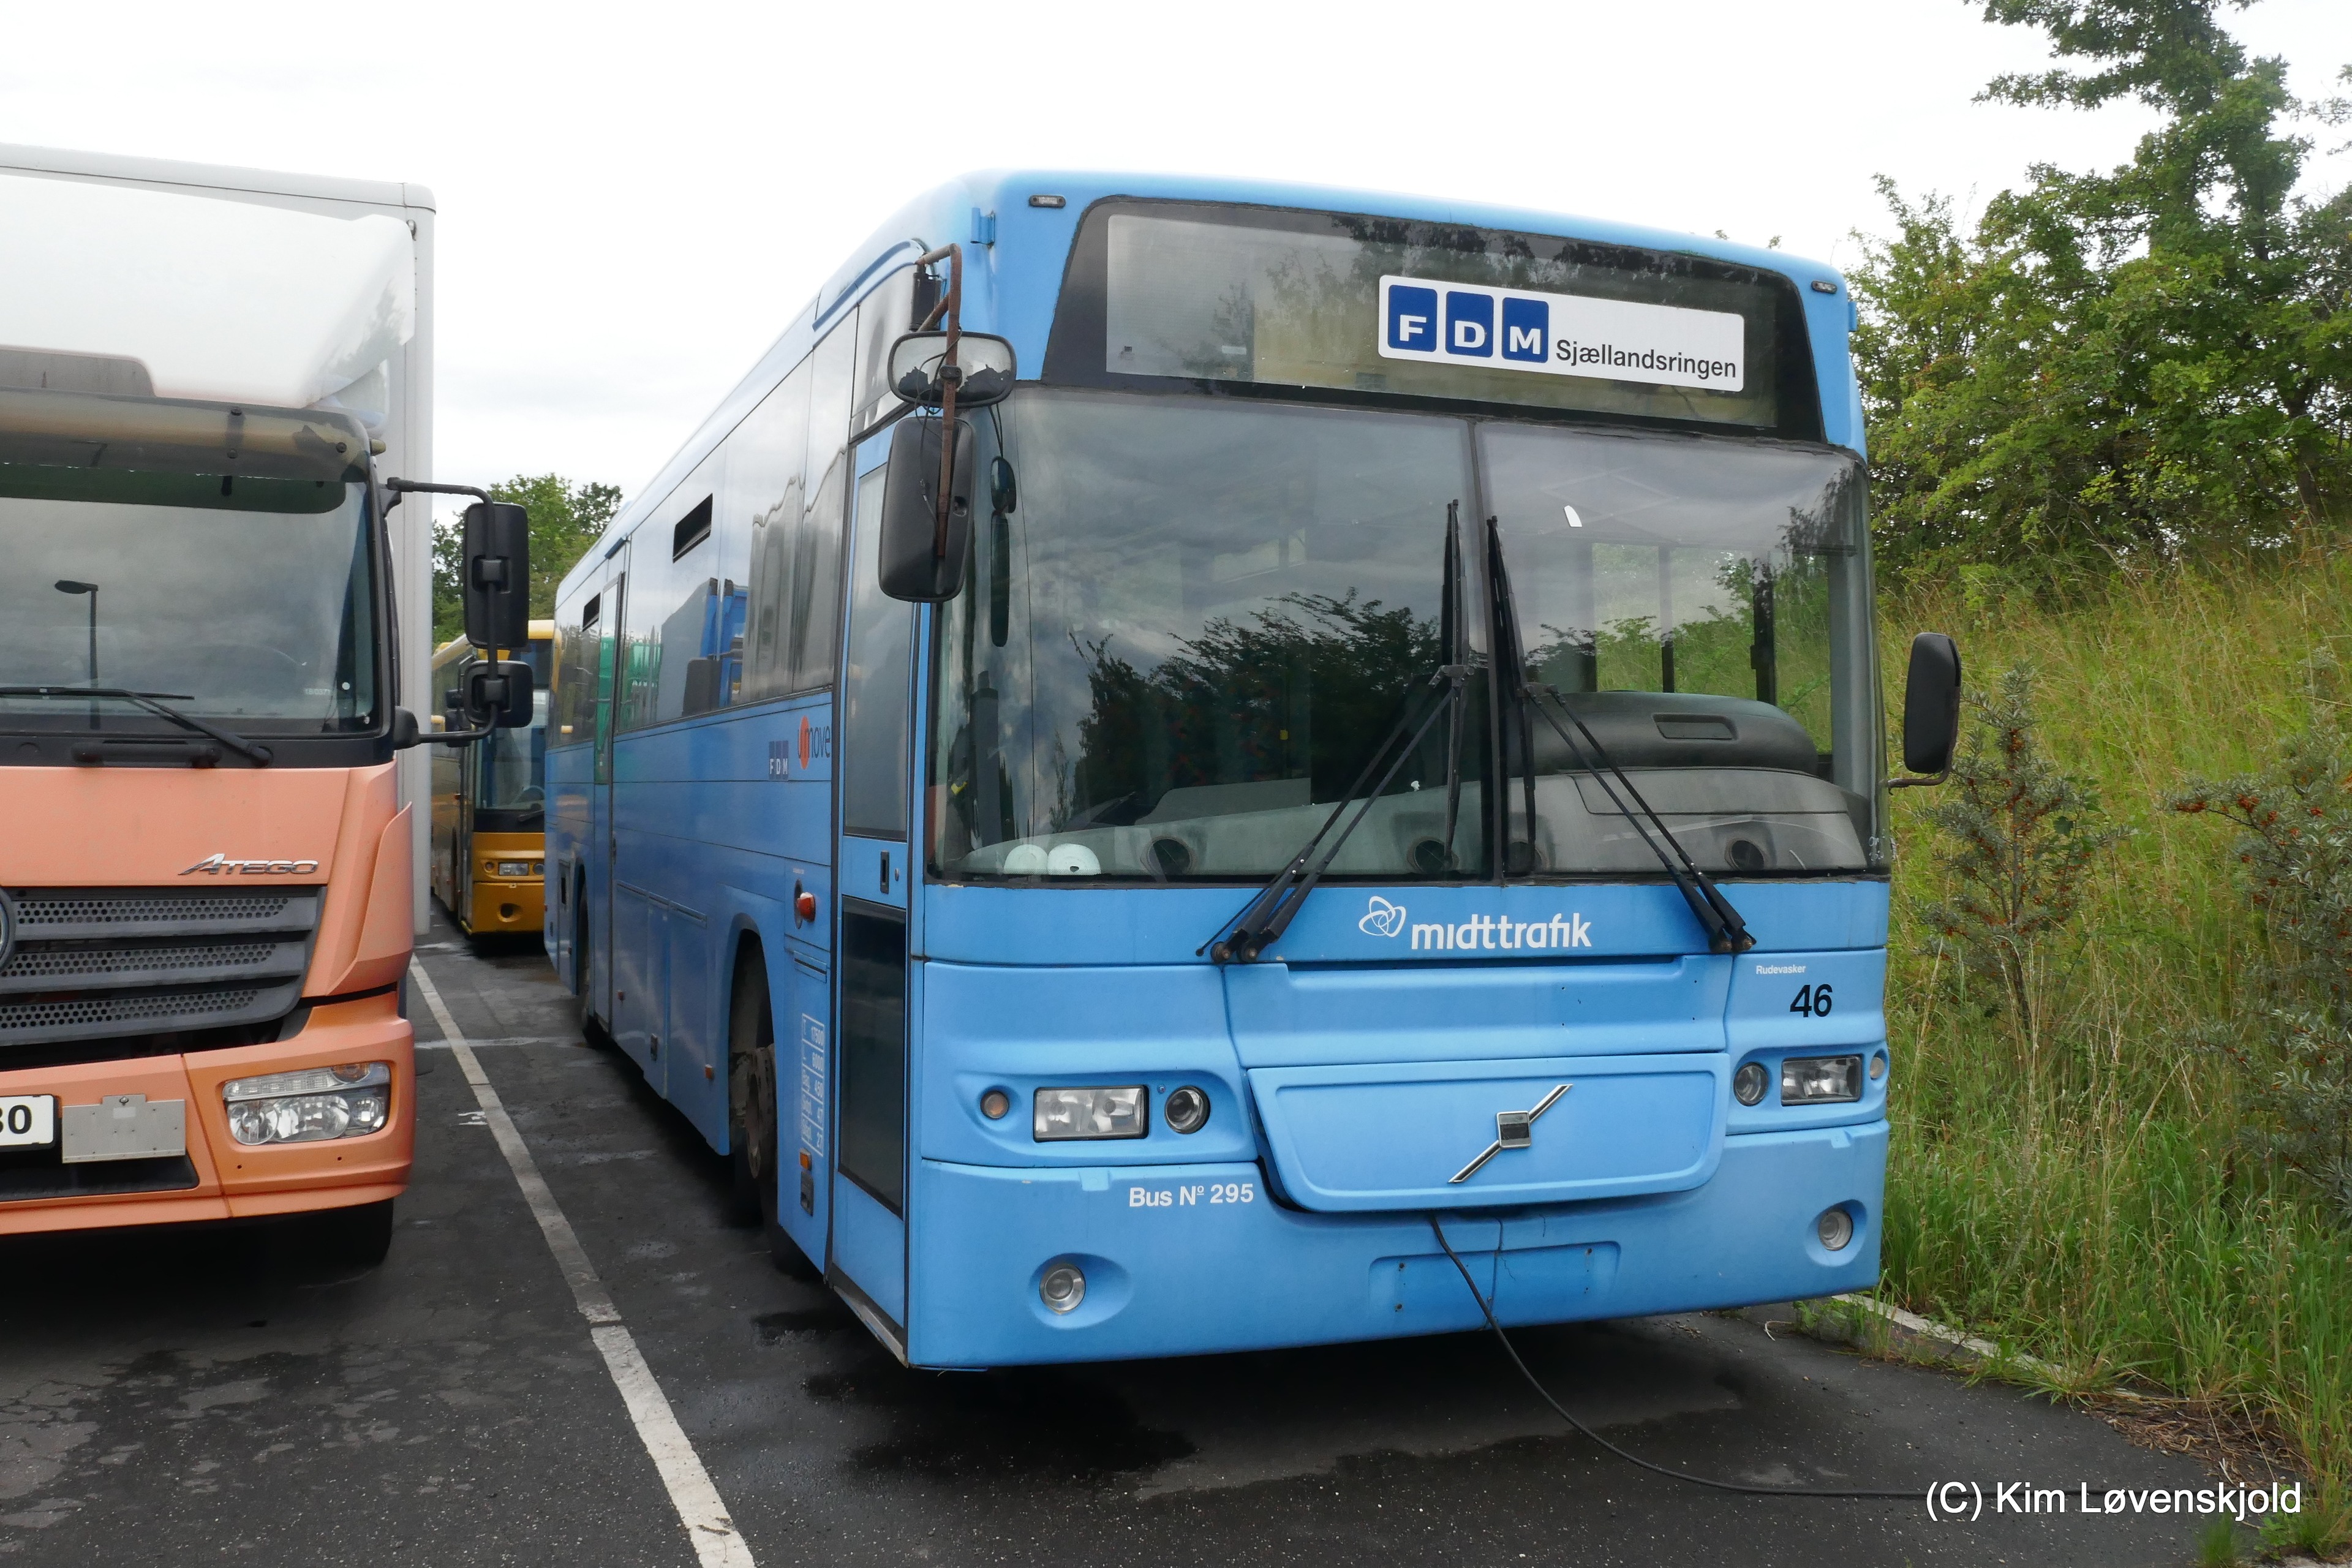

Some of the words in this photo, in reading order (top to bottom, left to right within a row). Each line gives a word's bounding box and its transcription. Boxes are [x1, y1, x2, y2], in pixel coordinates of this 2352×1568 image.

[1556, 339, 1736, 379] Sjællandsringen
[1411, 913, 1593, 949] midttrafik
[1755, 964, 1806, 974] Rudevasker
[1789, 984, 1833, 1018] 46
[1129, 1187, 1172, 1207] Bus
[1210, 1183, 1254, 1203] 295
